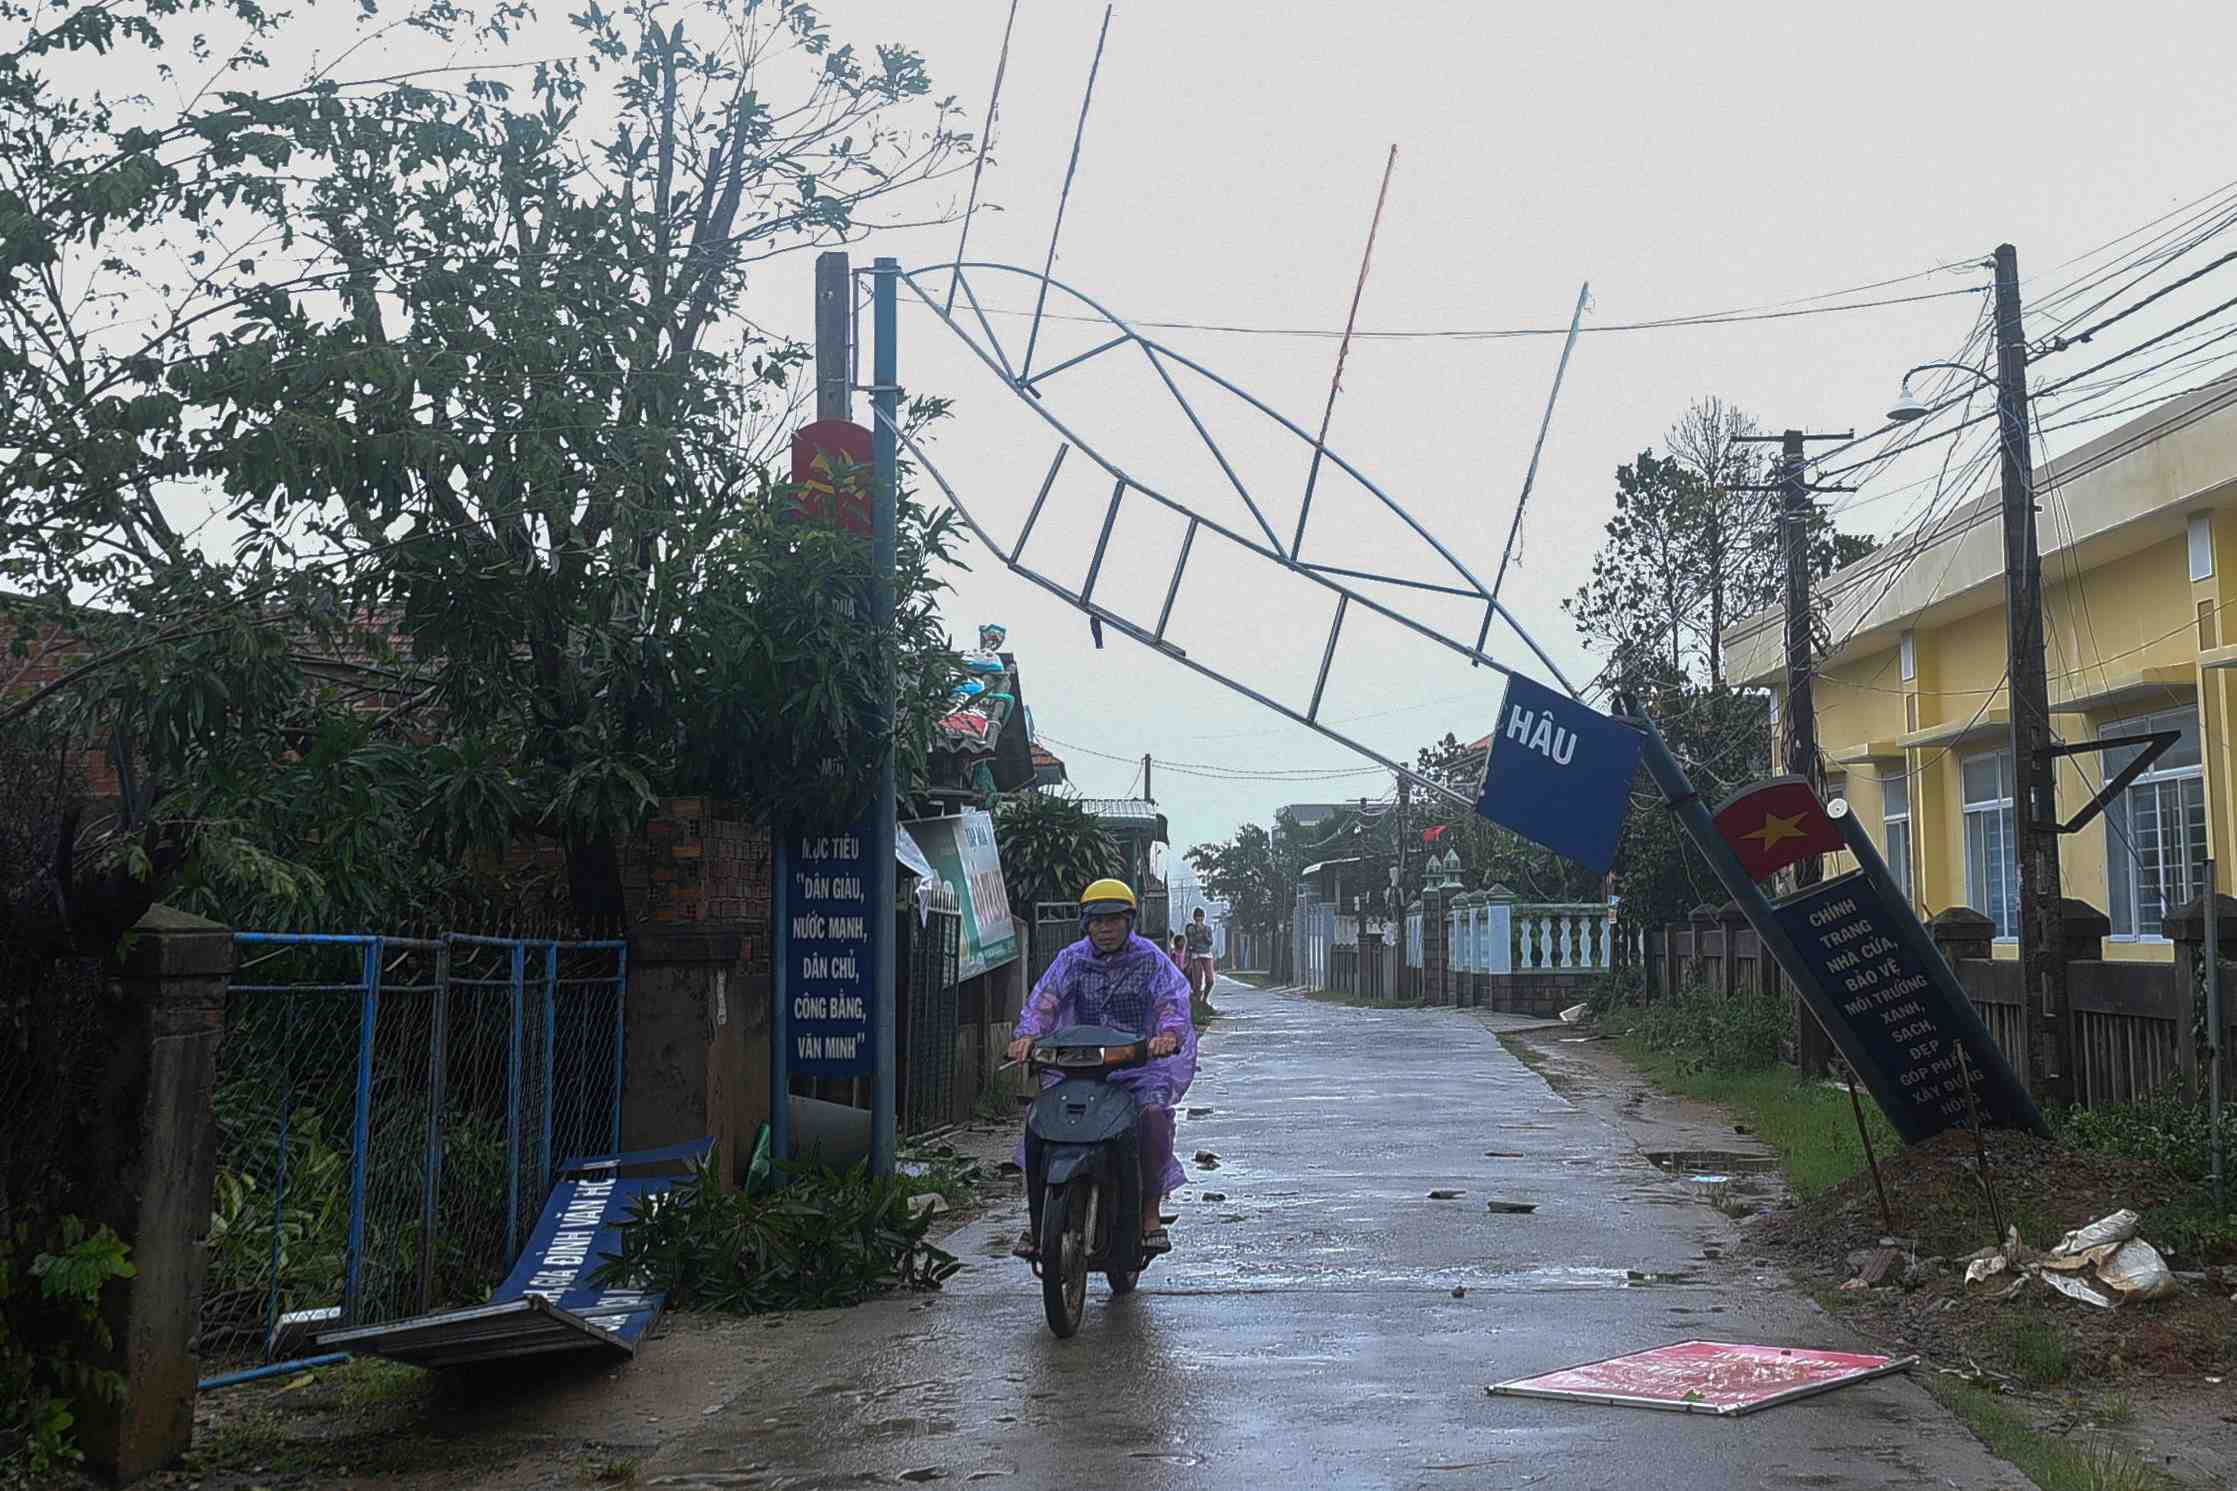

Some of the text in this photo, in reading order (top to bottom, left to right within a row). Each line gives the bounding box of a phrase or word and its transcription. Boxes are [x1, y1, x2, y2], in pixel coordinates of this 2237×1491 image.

[1506, 704, 1578, 765] HÂU
[831, 832, 860, 860] TIÊU
[832, 872, 865, 904] GIÀU,
[792, 909, 868, 944] NƯỚC MẠNH,
[1819, 919, 1873, 949] TRANG
[803, 948, 860, 985] DÂN CHỦ,
[1845, 957, 1902, 992] BẢO VỆ
[794, 987, 867, 1025] CÔNG BẰNG,
[1844, 996, 1873, 1017] MÔI
[1880, 1000, 1928, 1025] XANH,
[798, 1032, 823, 1060] VĂN
[1891, 1019, 1937, 1043] SẠCH,
[555, 1199, 608, 1228] VĂN
[536, 1230, 595, 1265] ĐÌNH
